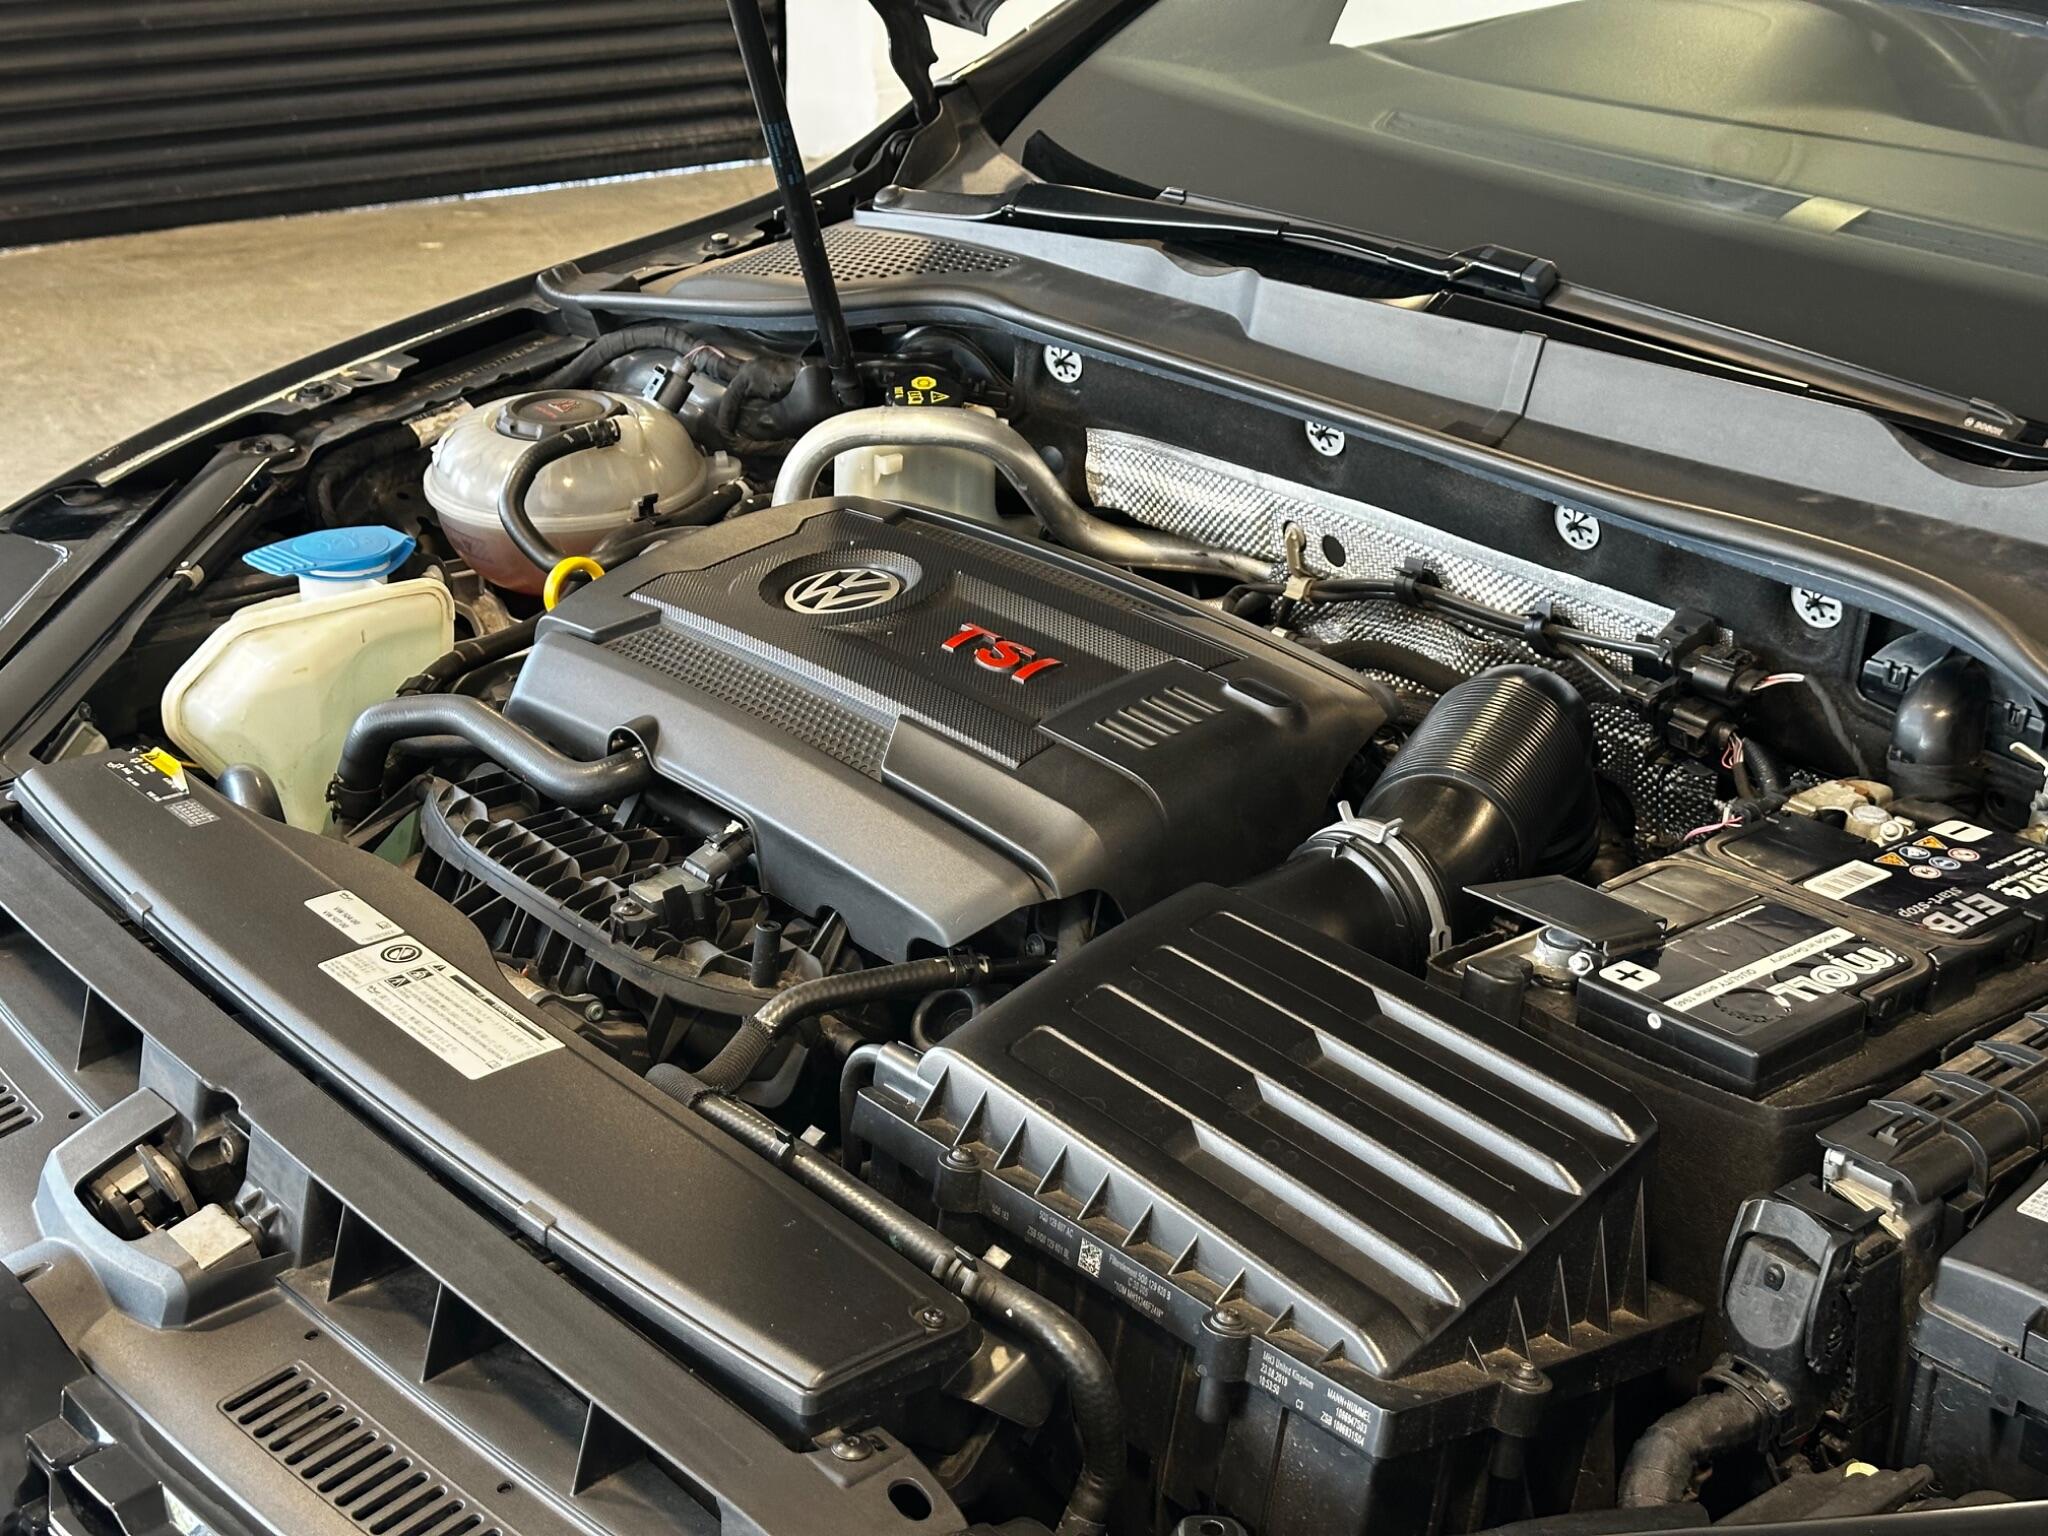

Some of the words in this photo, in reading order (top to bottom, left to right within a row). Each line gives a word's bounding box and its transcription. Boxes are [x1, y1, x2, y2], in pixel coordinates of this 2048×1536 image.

[941, 622, 1062, 685] TSI
[1898, 887, 1964, 918] start-stop
[1922, 893, 2009, 934] EFB
[1292, 1368, 1314, 1390] Kingdom
